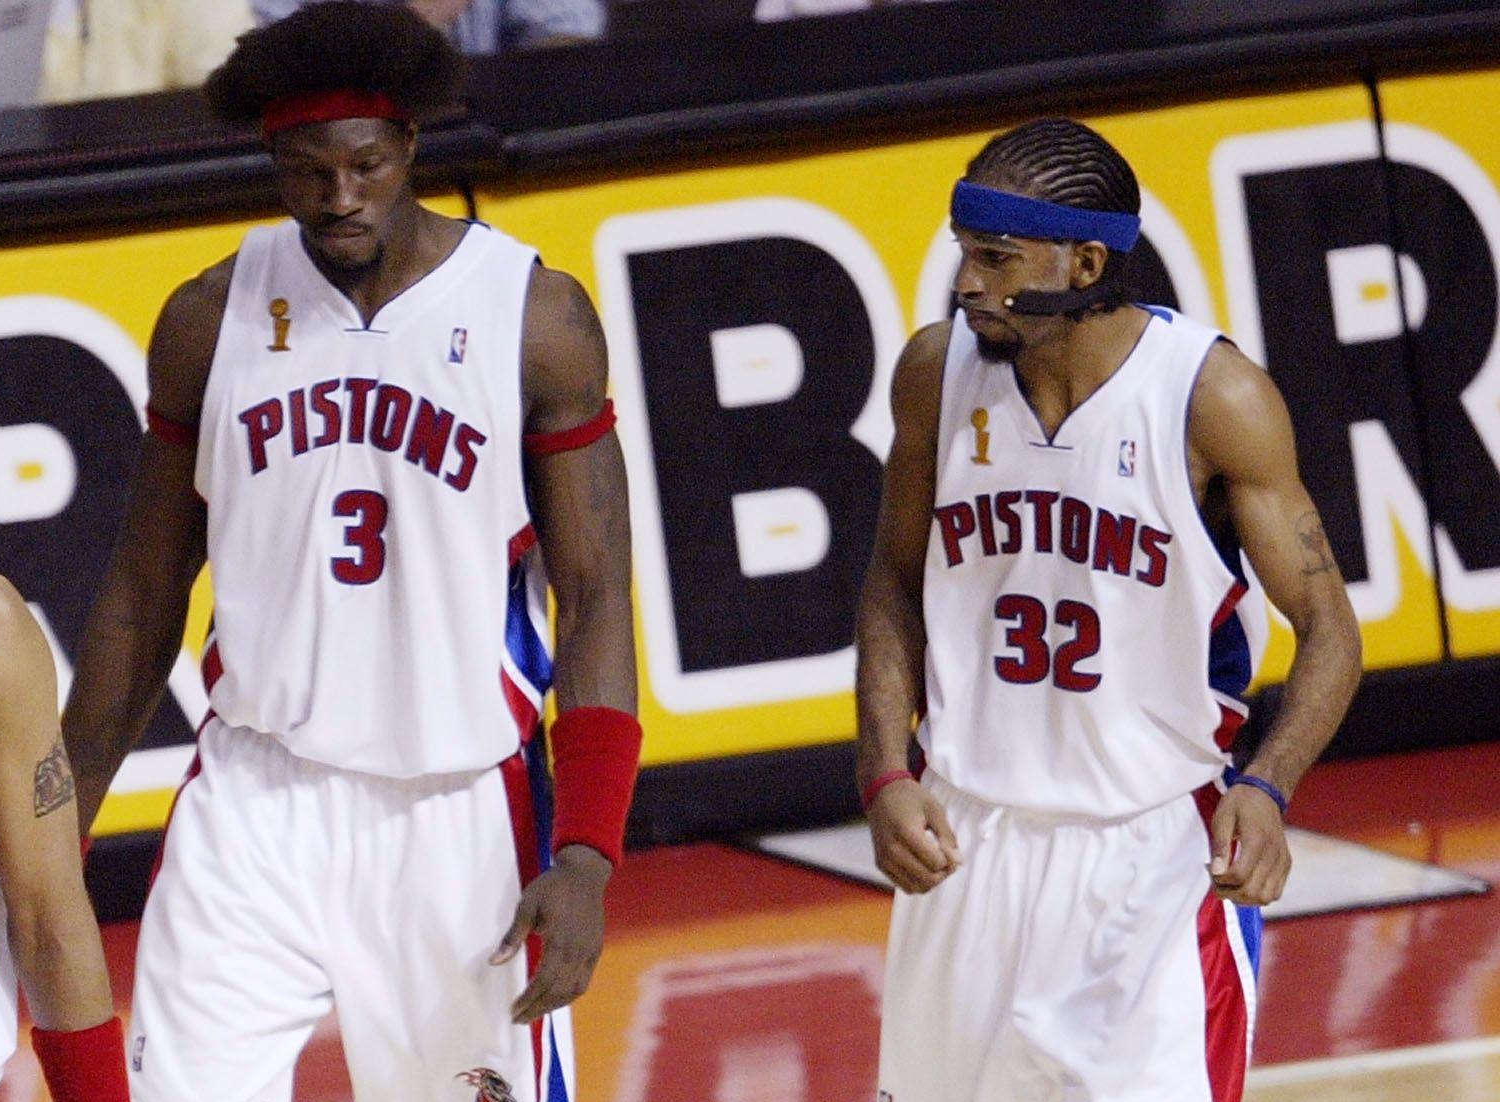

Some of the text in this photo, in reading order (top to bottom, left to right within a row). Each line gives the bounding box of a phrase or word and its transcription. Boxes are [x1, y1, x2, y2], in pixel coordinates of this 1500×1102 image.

[238, 377, 487, 493] PISTONS
[331, 489, 390, 586] 3
[933, 489, 1173, 588] PISTONS
[993, 593, 1102, 693] 32
